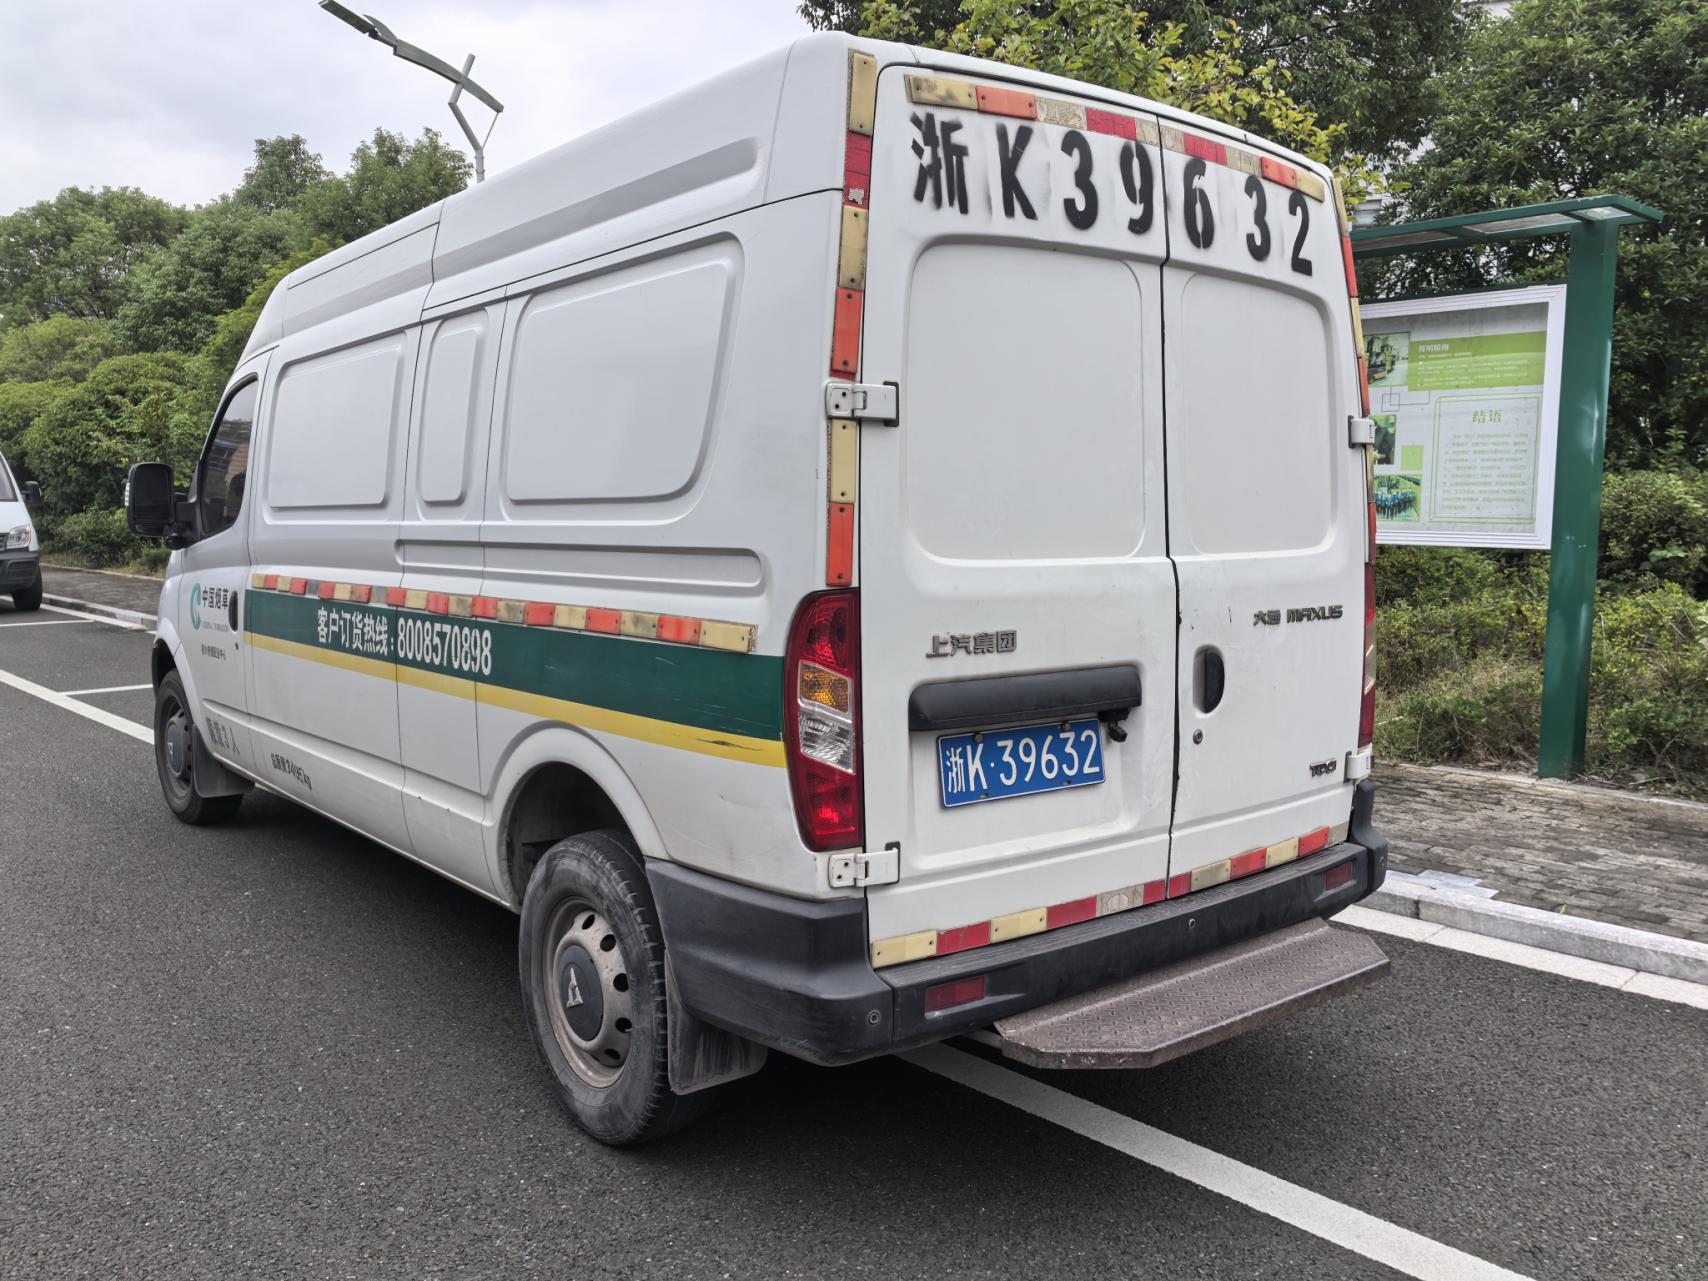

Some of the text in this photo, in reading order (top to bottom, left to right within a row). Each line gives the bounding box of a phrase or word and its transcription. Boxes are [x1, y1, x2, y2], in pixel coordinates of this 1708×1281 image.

[910, 112, 1313, 277] 浙K39632
[202, 585, 229, 610] 中国烟草
[1253, 605, 1343, 626] 大通 MAXUS
[926, 630, 1017, 658] 上汽集团
[945, 729, 1100, 794] 浙K·39632
